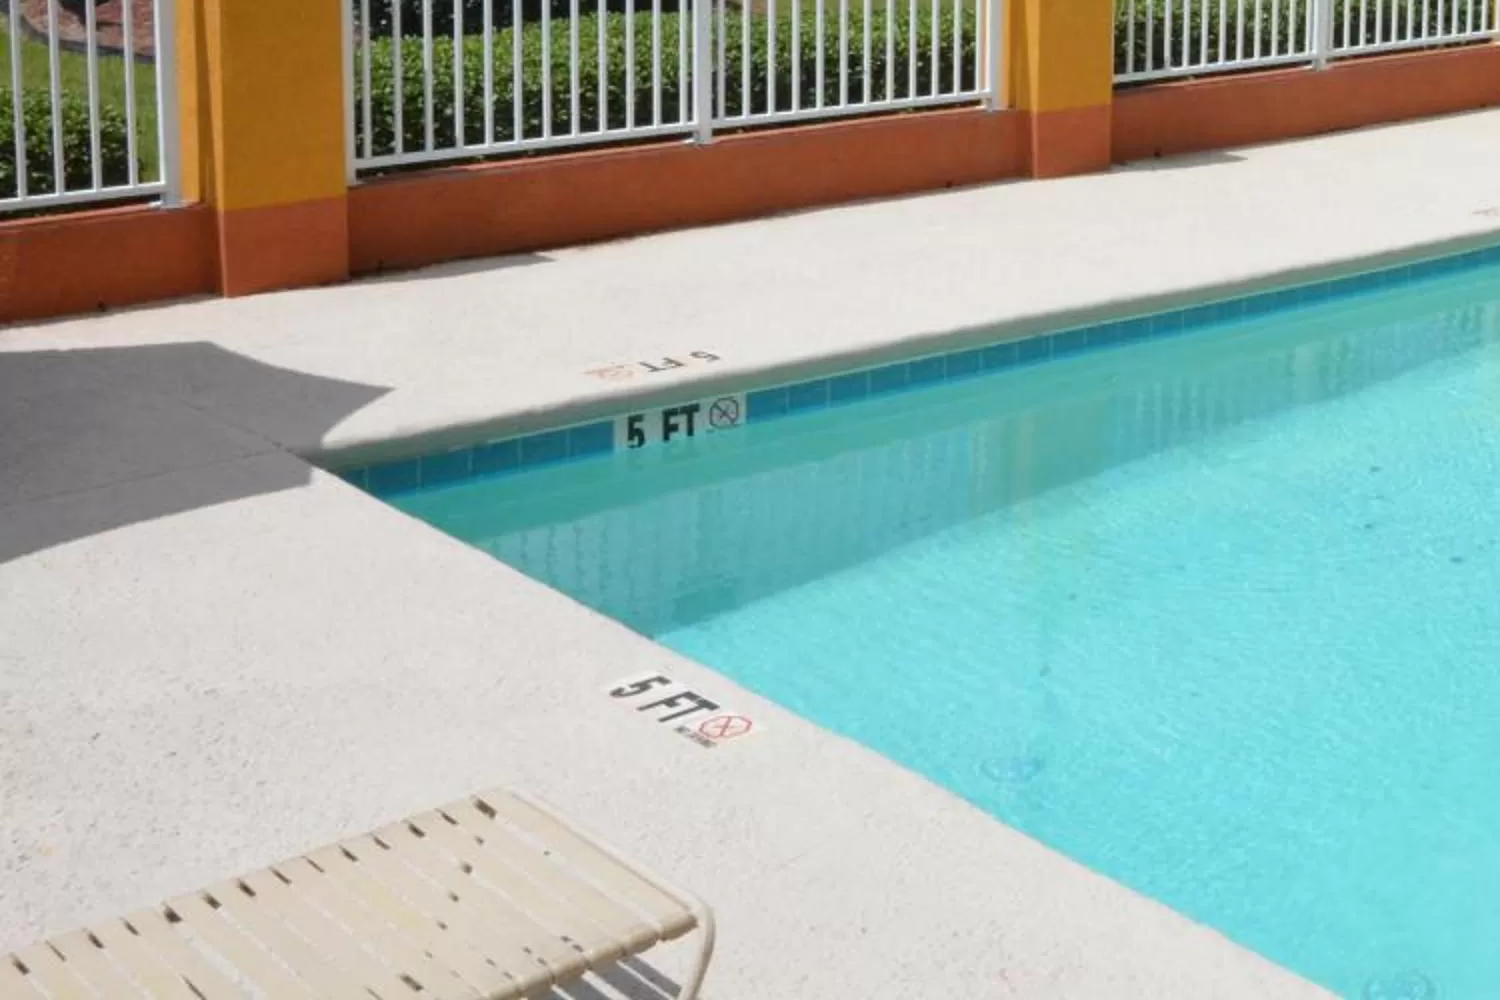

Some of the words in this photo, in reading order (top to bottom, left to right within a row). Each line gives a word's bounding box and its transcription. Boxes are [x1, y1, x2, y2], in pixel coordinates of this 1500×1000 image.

[626, 413, 646, 449] 5
[660, 403, 700, 442] FT
[609, 675, 672, 698] 5
[635, 690, 721, 723] FT
